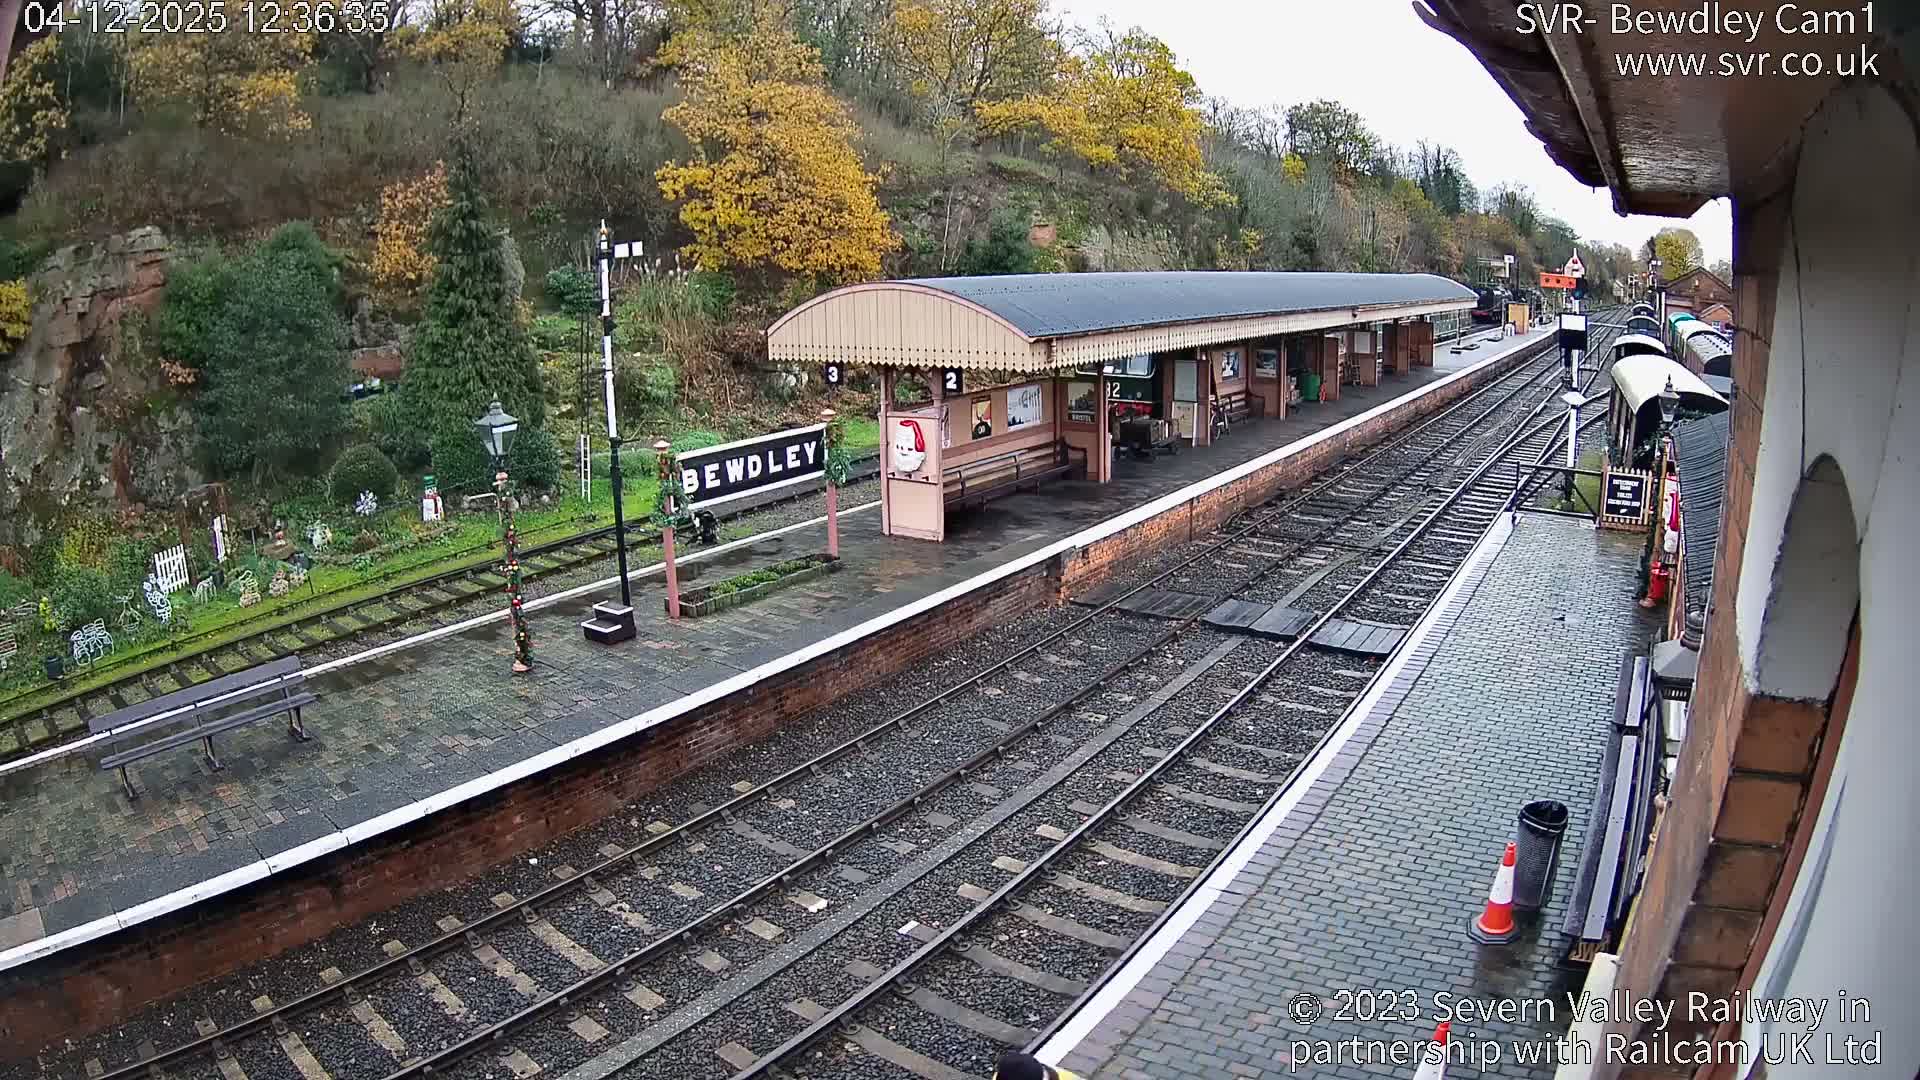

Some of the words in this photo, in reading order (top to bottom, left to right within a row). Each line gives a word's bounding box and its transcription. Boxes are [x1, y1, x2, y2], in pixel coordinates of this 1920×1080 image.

[827, 366, 839, 384] 3
[945, 371, 957, 390] 2
[682, 440, 818, 494] BEWDLEY
